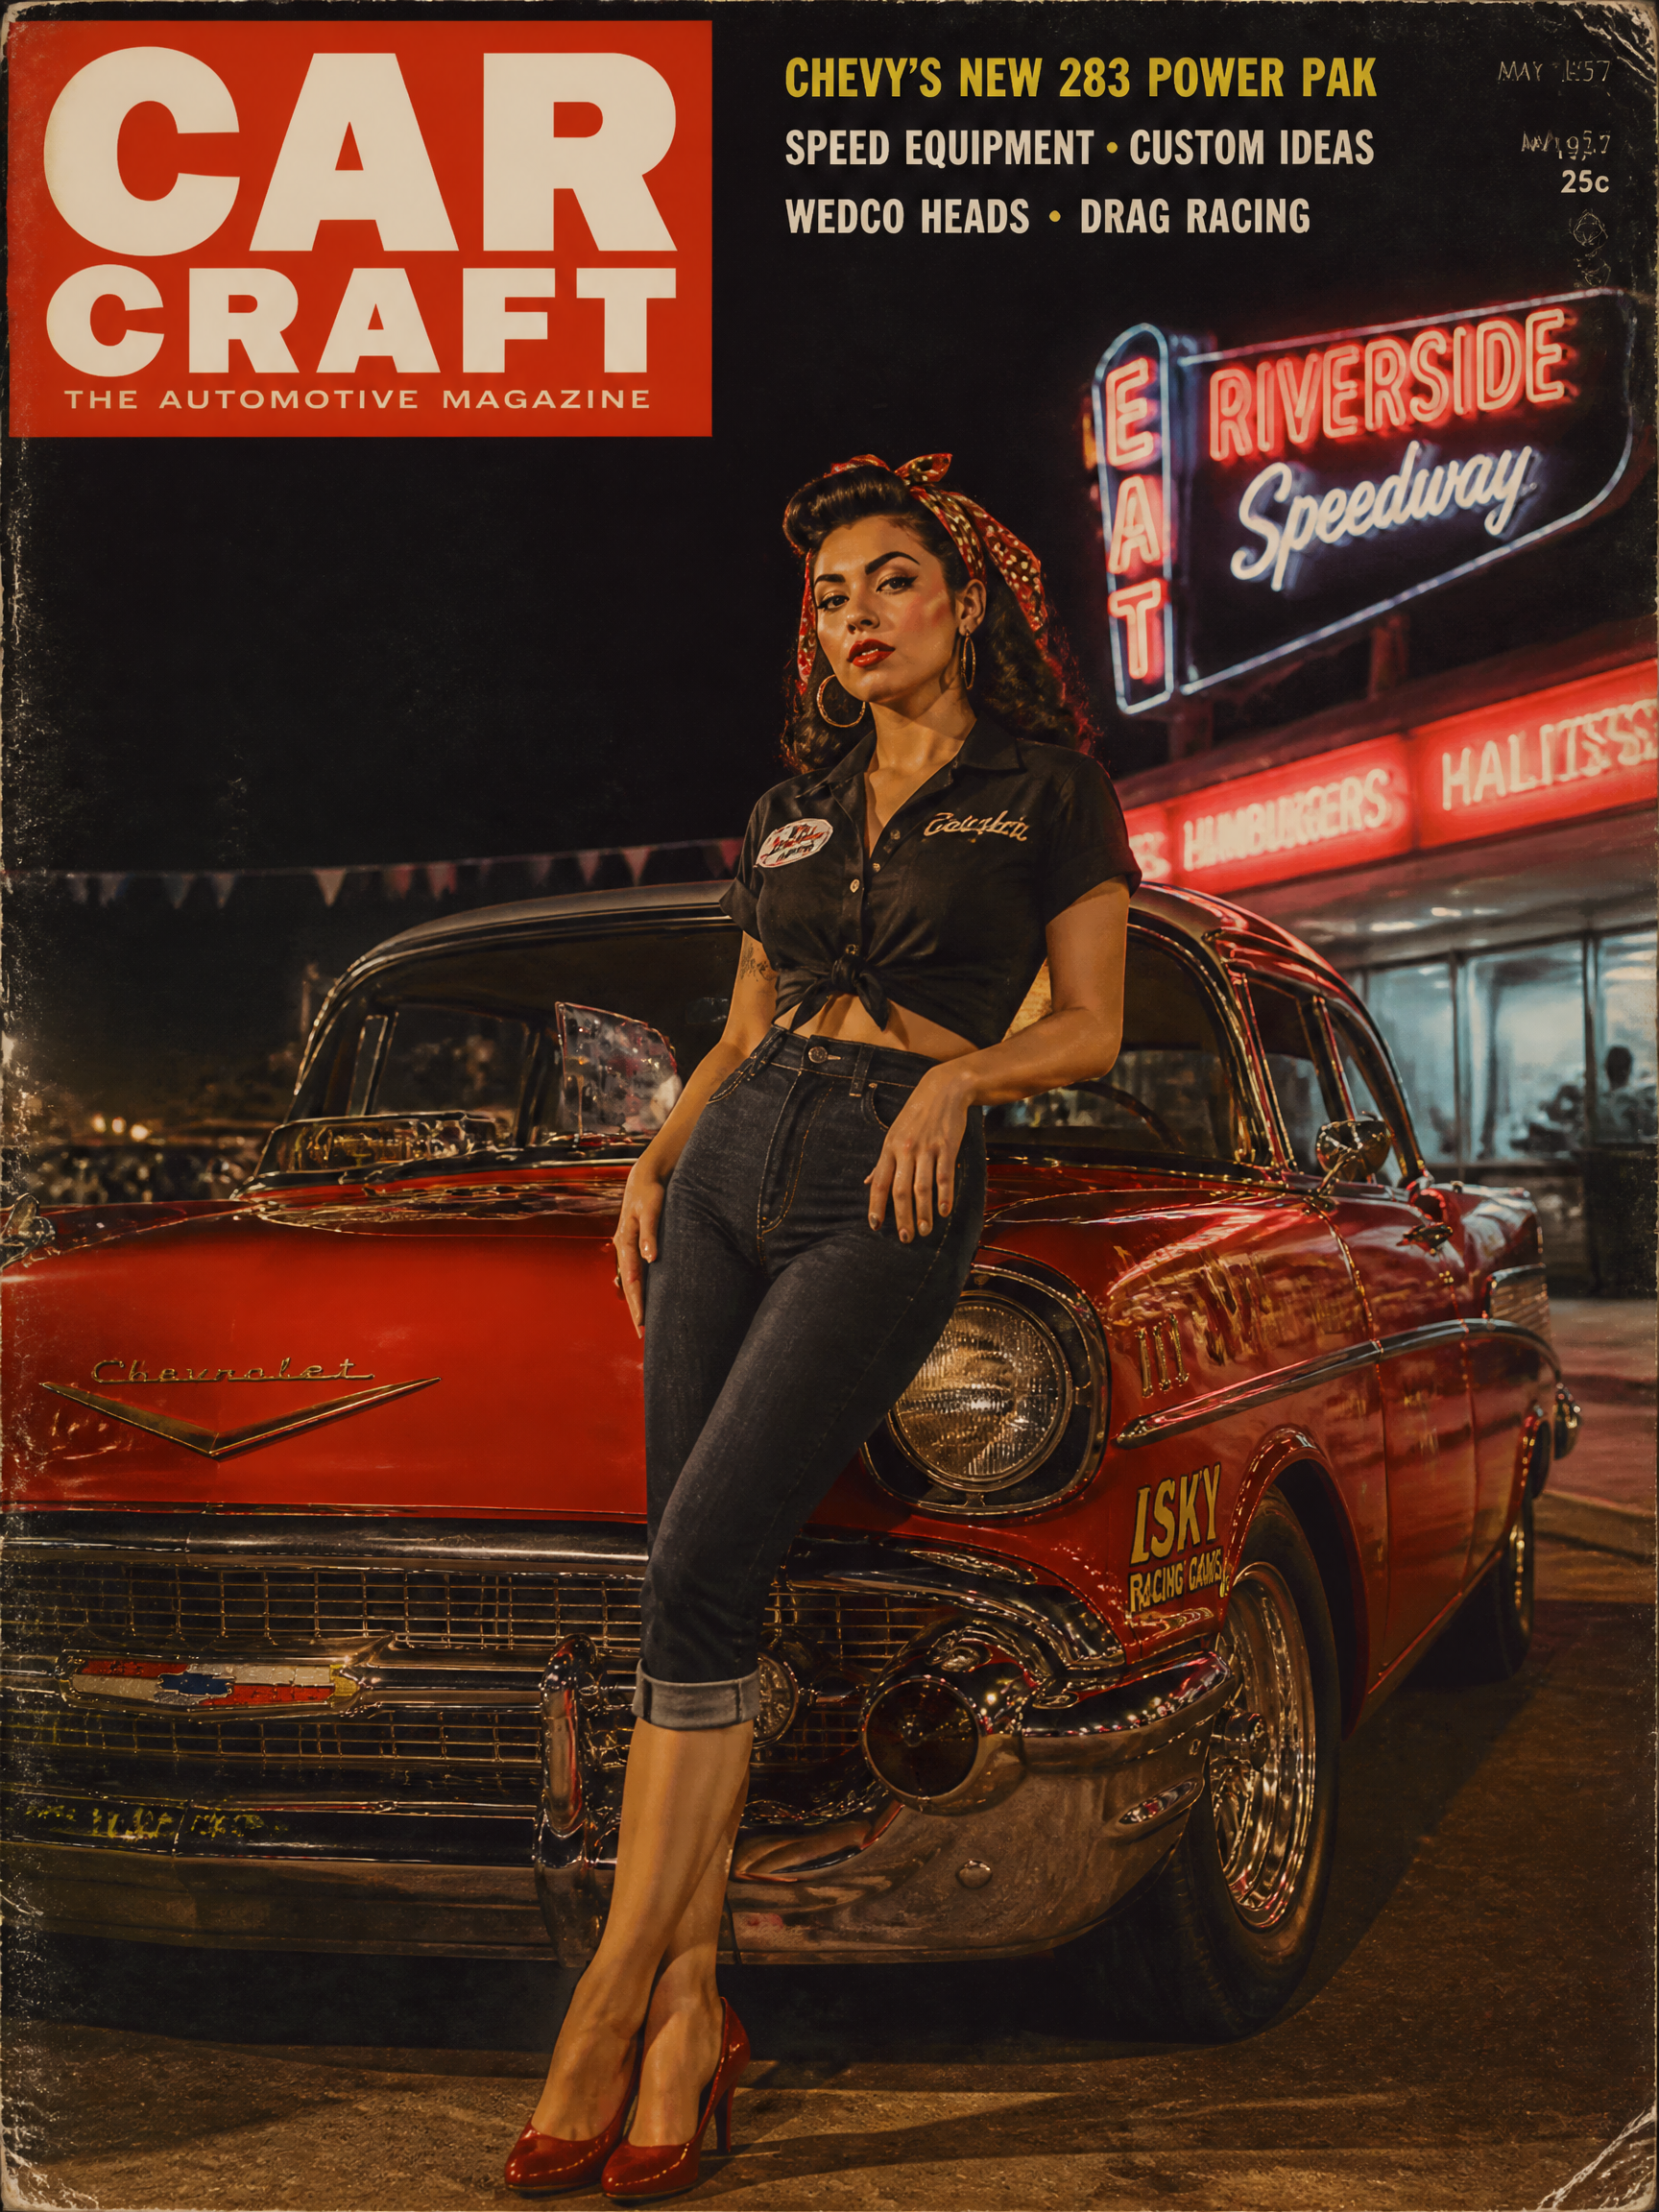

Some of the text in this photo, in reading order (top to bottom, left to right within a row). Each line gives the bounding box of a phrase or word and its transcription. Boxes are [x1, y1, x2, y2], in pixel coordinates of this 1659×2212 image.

[1209, 308, 1567, 462] RIVERSIDE
[1105, 356, 1163, 681] EAT
[1230, 440, 1533, 591] Speedway
[90, 1357, 376, 1383] Chevrolet
[1129, 1461, 1221, 1566] ISKY
[1129, 1559, 1188, 1612] RACING
